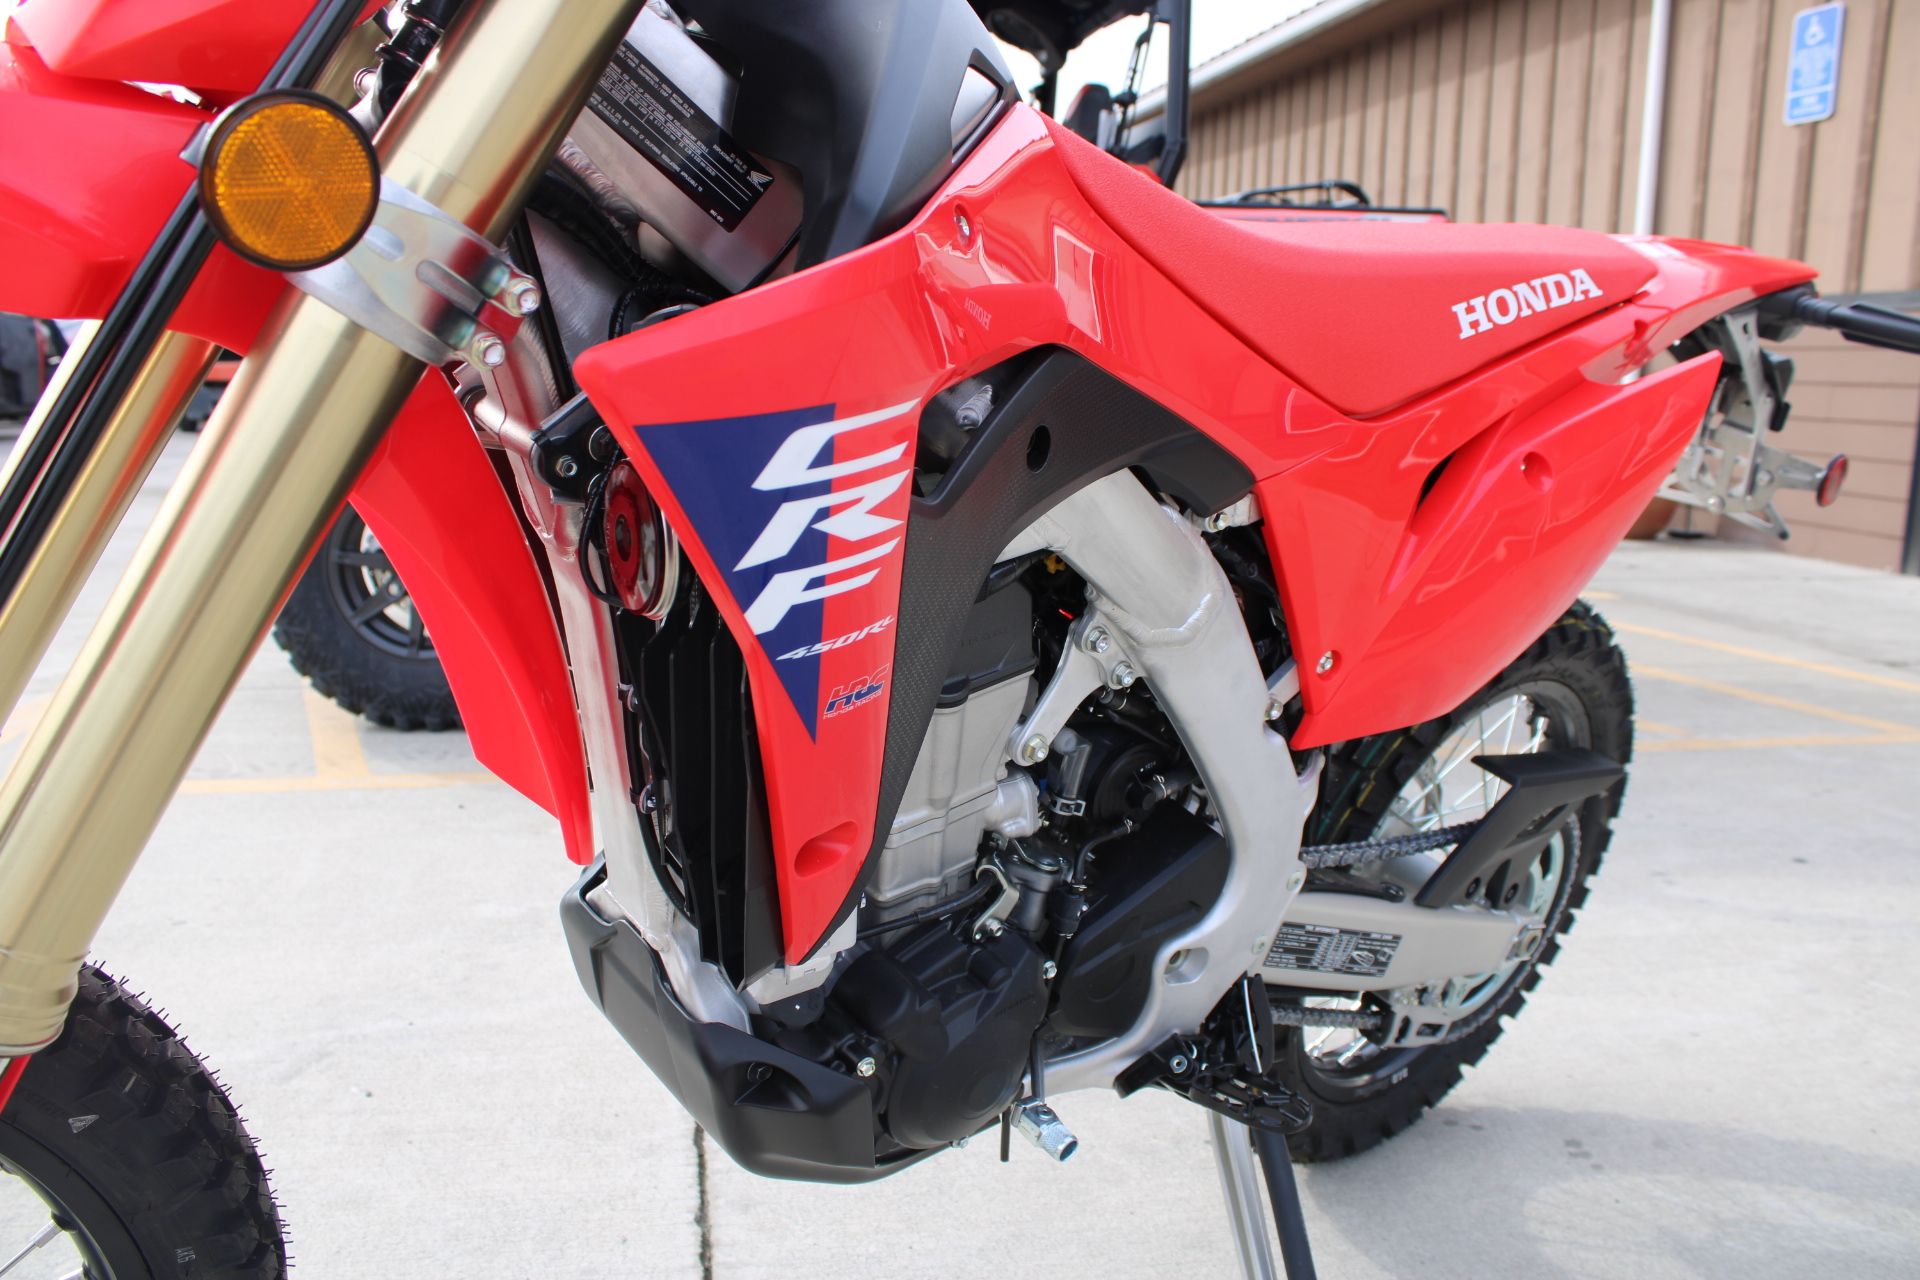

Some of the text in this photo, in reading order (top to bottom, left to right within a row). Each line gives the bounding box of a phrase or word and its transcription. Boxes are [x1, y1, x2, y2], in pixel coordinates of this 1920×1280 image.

[1451, 268, 1603, 340] HONDA
[733, 398, 921, 635] CRF
[776, 614, 896, 661] 450RL
